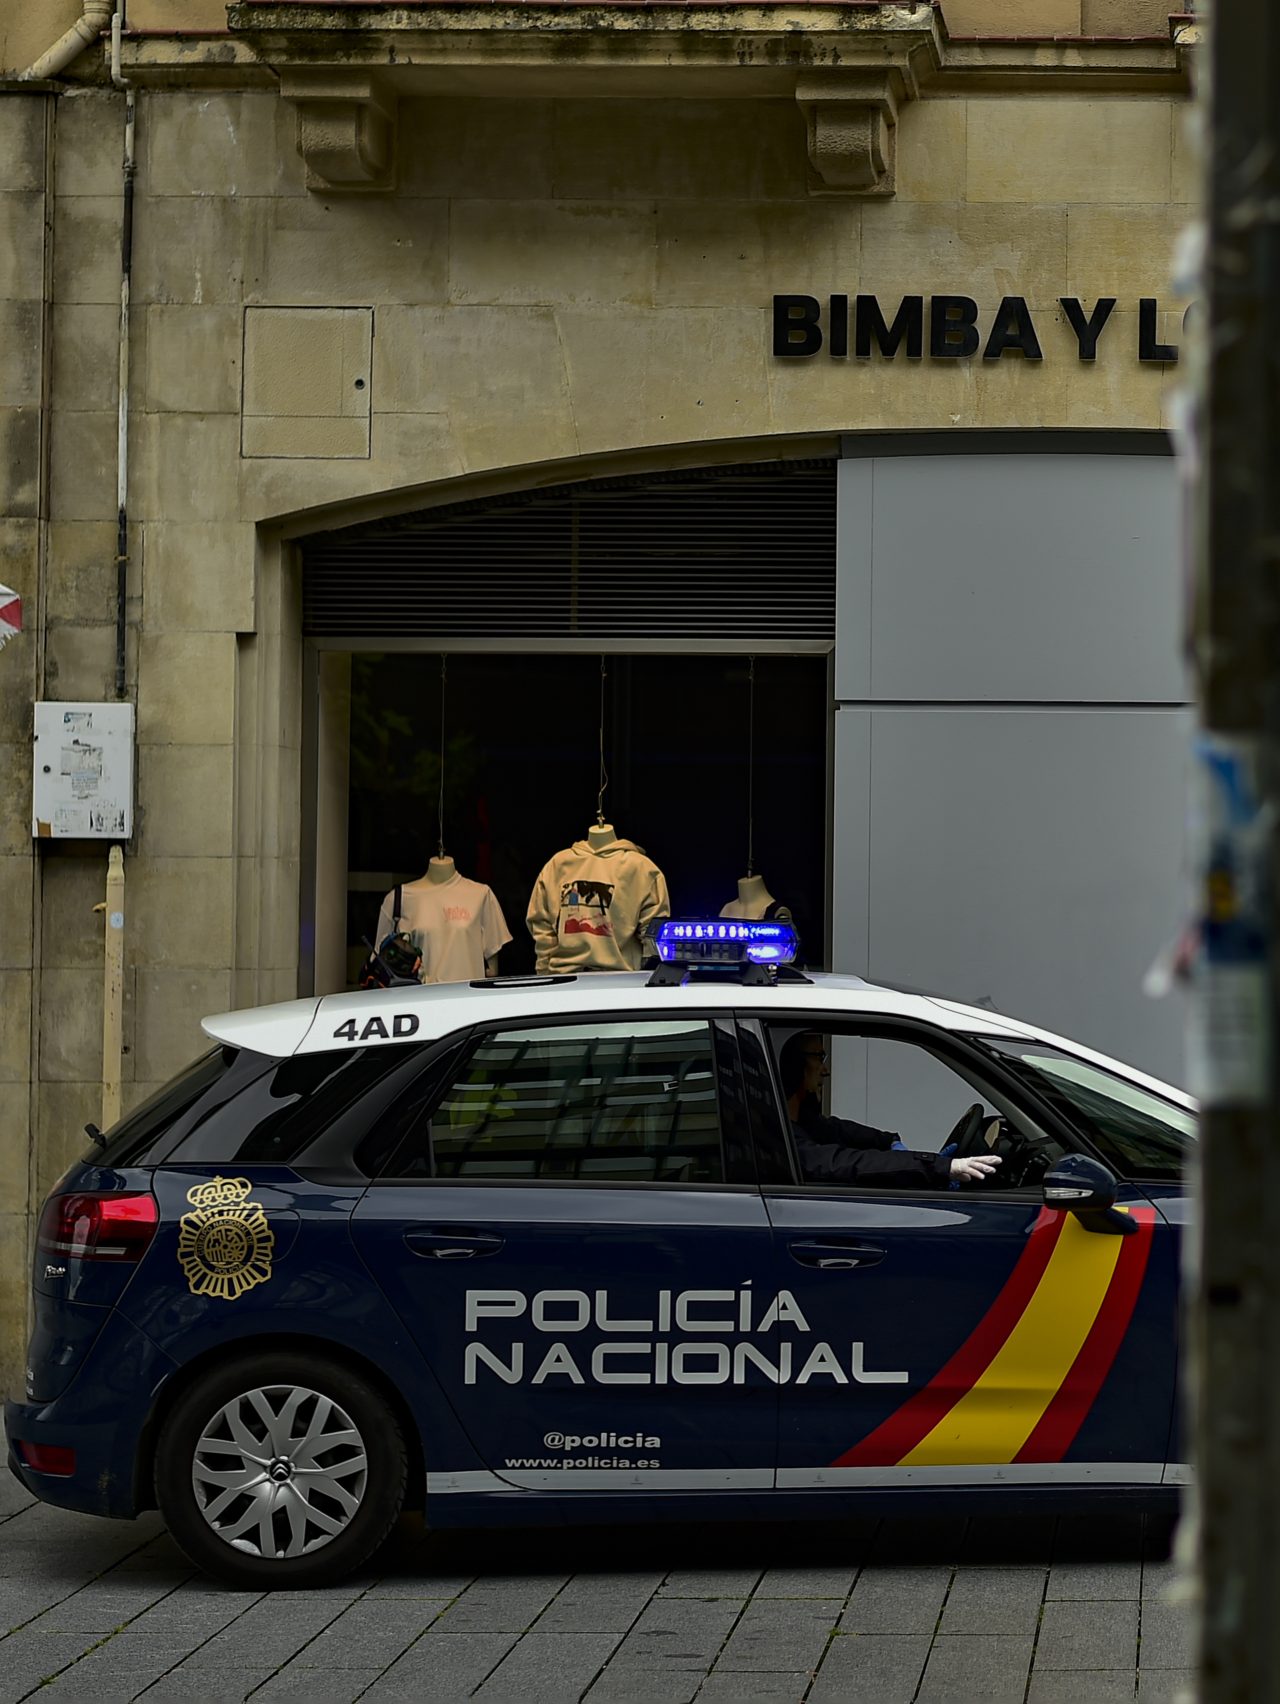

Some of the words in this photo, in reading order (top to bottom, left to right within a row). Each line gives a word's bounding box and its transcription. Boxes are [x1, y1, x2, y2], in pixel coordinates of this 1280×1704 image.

[772, 294, 1043, 361] BIMBA
[1059, 297, 1117, 361] Y
[332, 1013, 420, 1042] 4AD
[464, 1279, 811, 1332] POLICÍA
[464, 1342, 909, 1385] NACIONAL
[543, 1431, 661, 1451] @policia
[505, 1456, 661, 1470] www.policia.es
